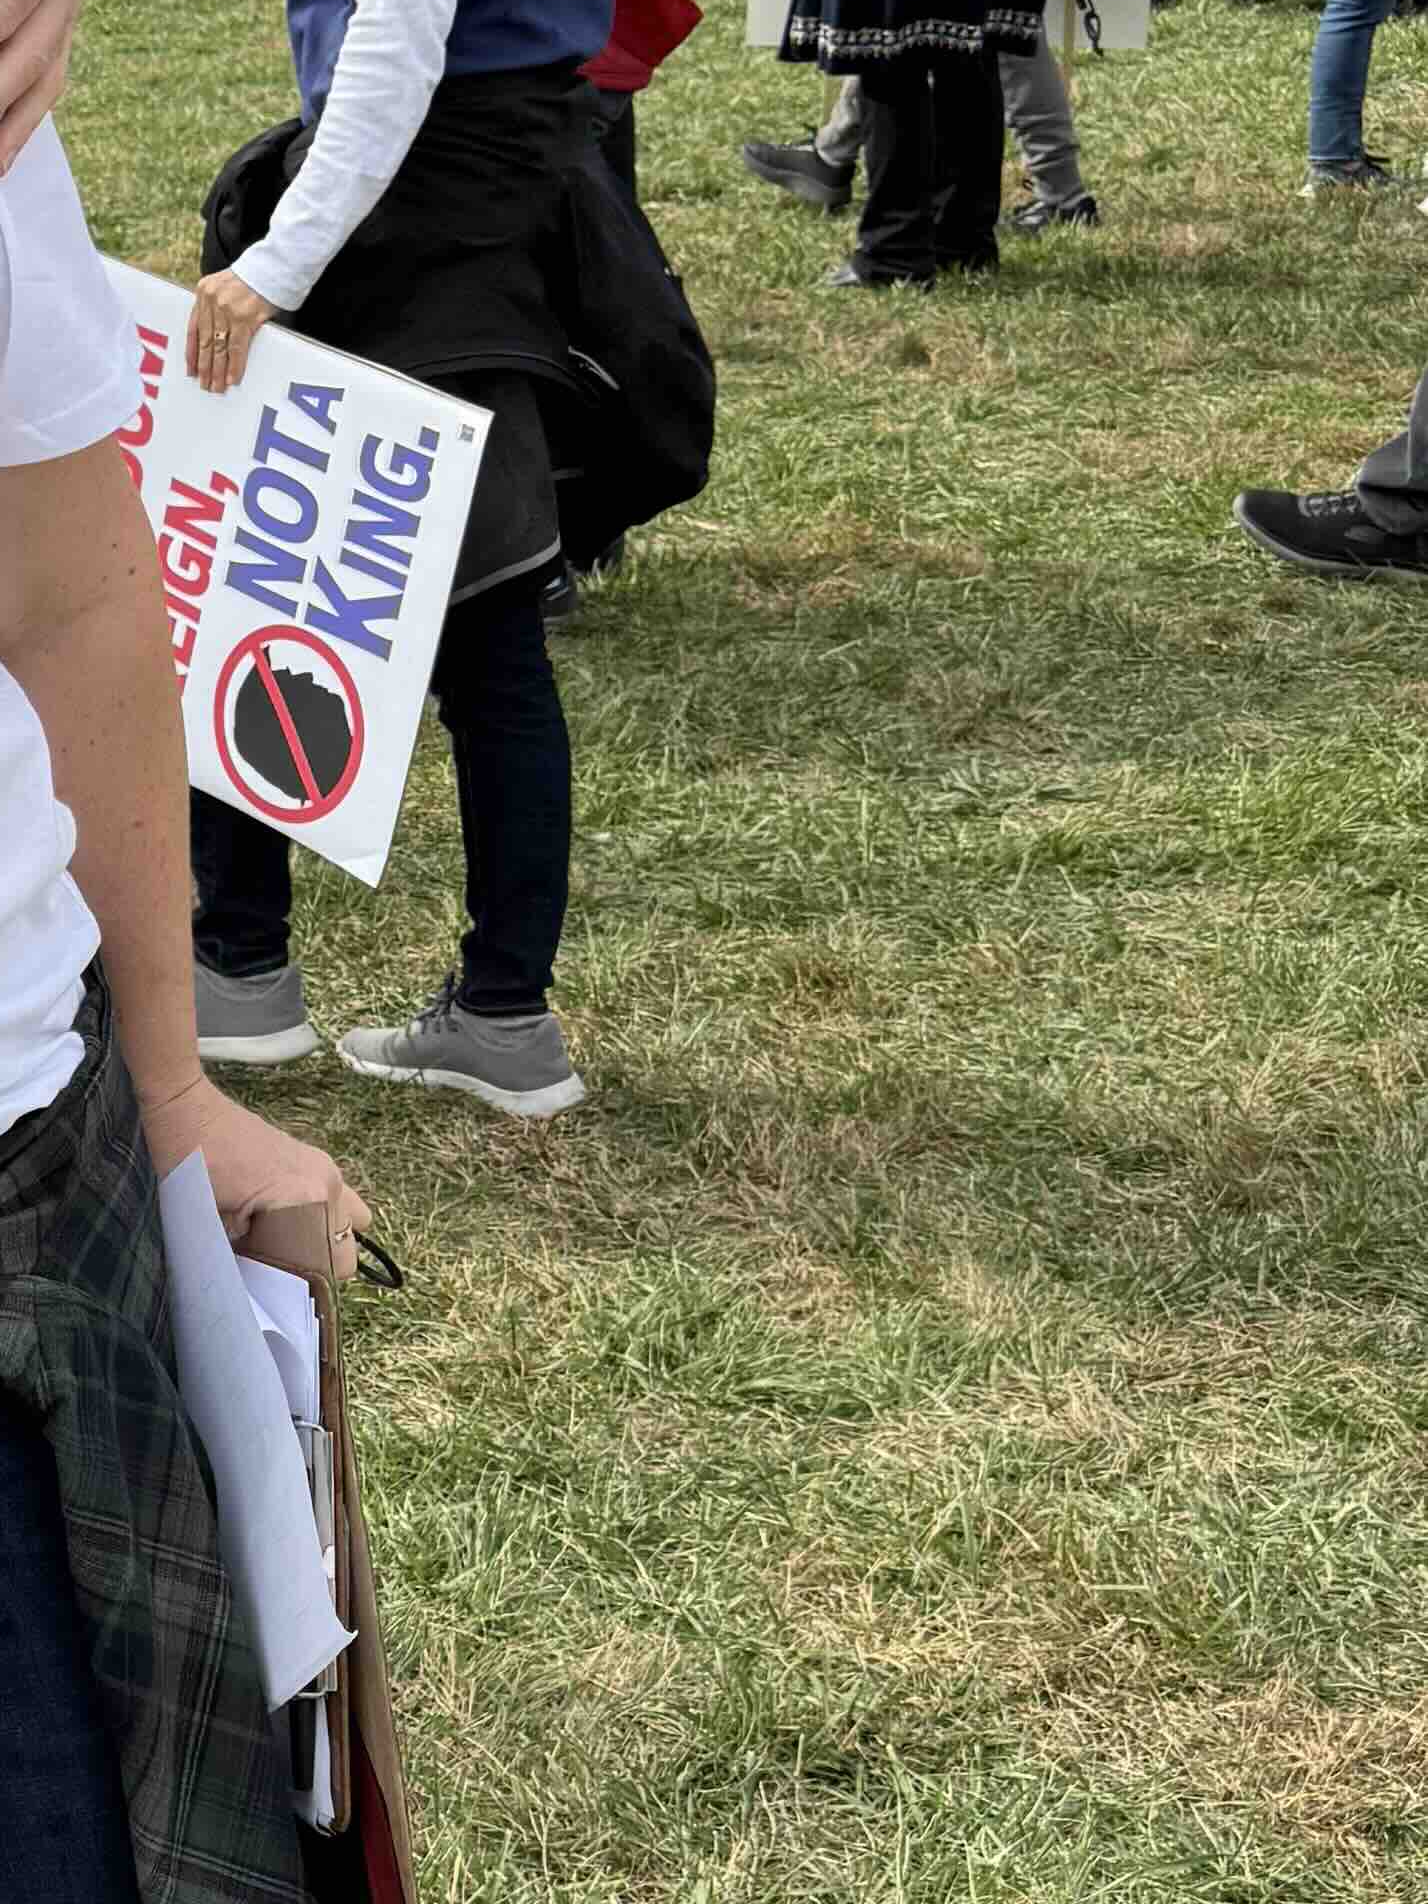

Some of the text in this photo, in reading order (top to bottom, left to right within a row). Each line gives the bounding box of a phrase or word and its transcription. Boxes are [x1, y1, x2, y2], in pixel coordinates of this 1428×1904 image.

[224, 381, 345, 619] NOT A
[303, 425, 441, 663] KING.
